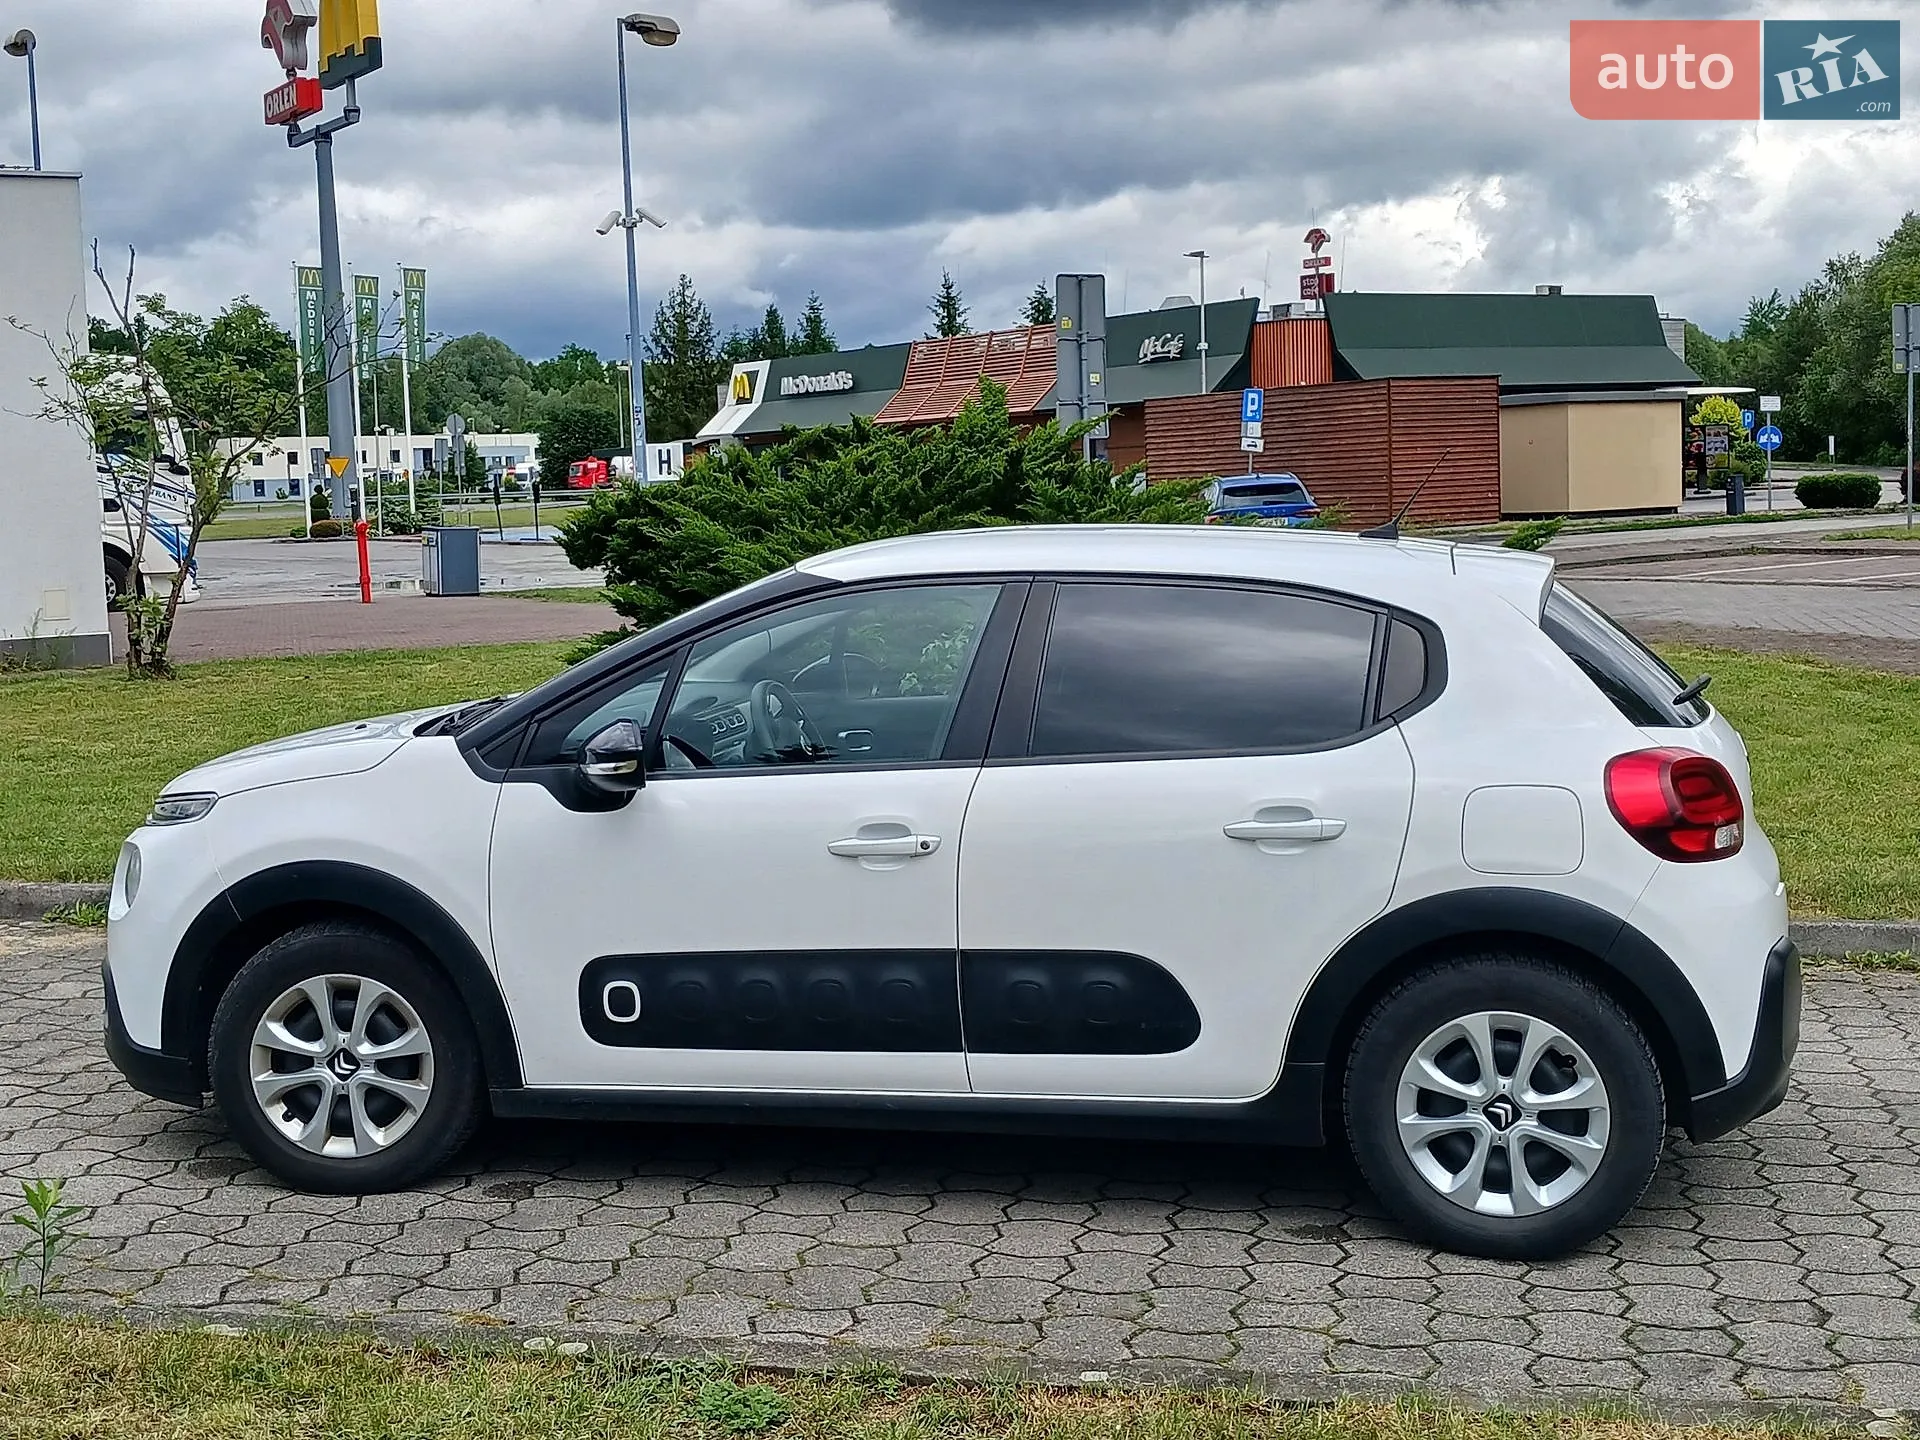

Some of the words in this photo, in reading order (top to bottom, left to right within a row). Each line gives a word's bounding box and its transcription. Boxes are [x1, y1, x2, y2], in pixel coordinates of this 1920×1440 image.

[266, 84, 297, 118] ORLEN
[780, 371, 854, 396] McDonald's
[657, 448, 672, 476] H
